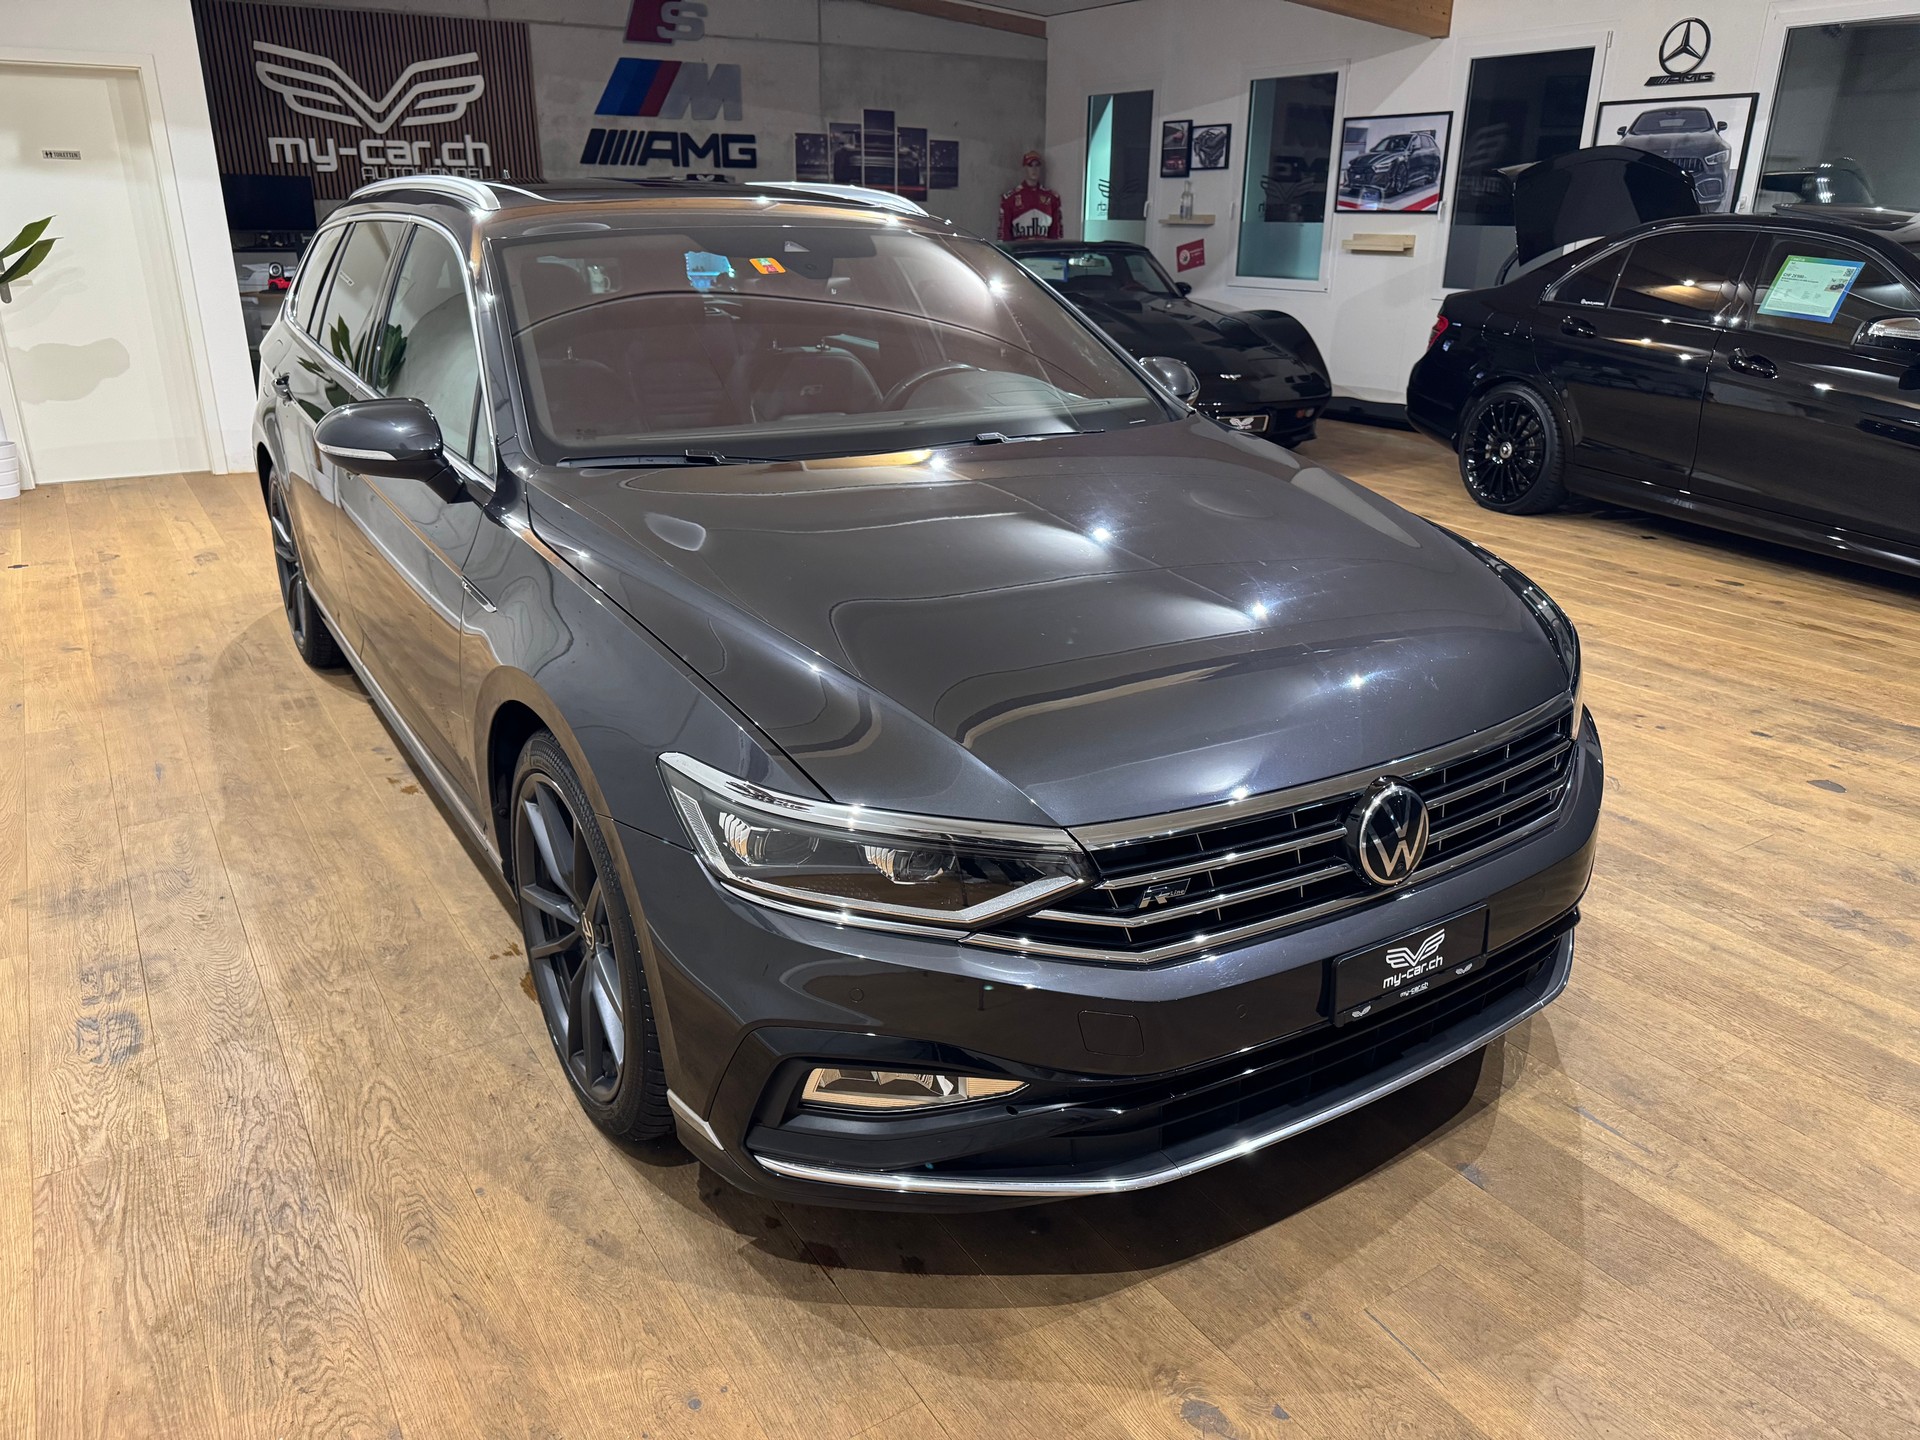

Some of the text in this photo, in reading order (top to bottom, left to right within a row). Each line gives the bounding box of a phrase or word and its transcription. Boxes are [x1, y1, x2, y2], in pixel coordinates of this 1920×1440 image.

[656, 0, 709, 42] S
[659, 61, 743, 121] M
[267, 134, 492, 172] my-car.ch
[637, 130, 757, 169] AMG
[1382, 955, 1444, 989] my-car.ch
[1400, 981, 1429, 998] my-car.ch
